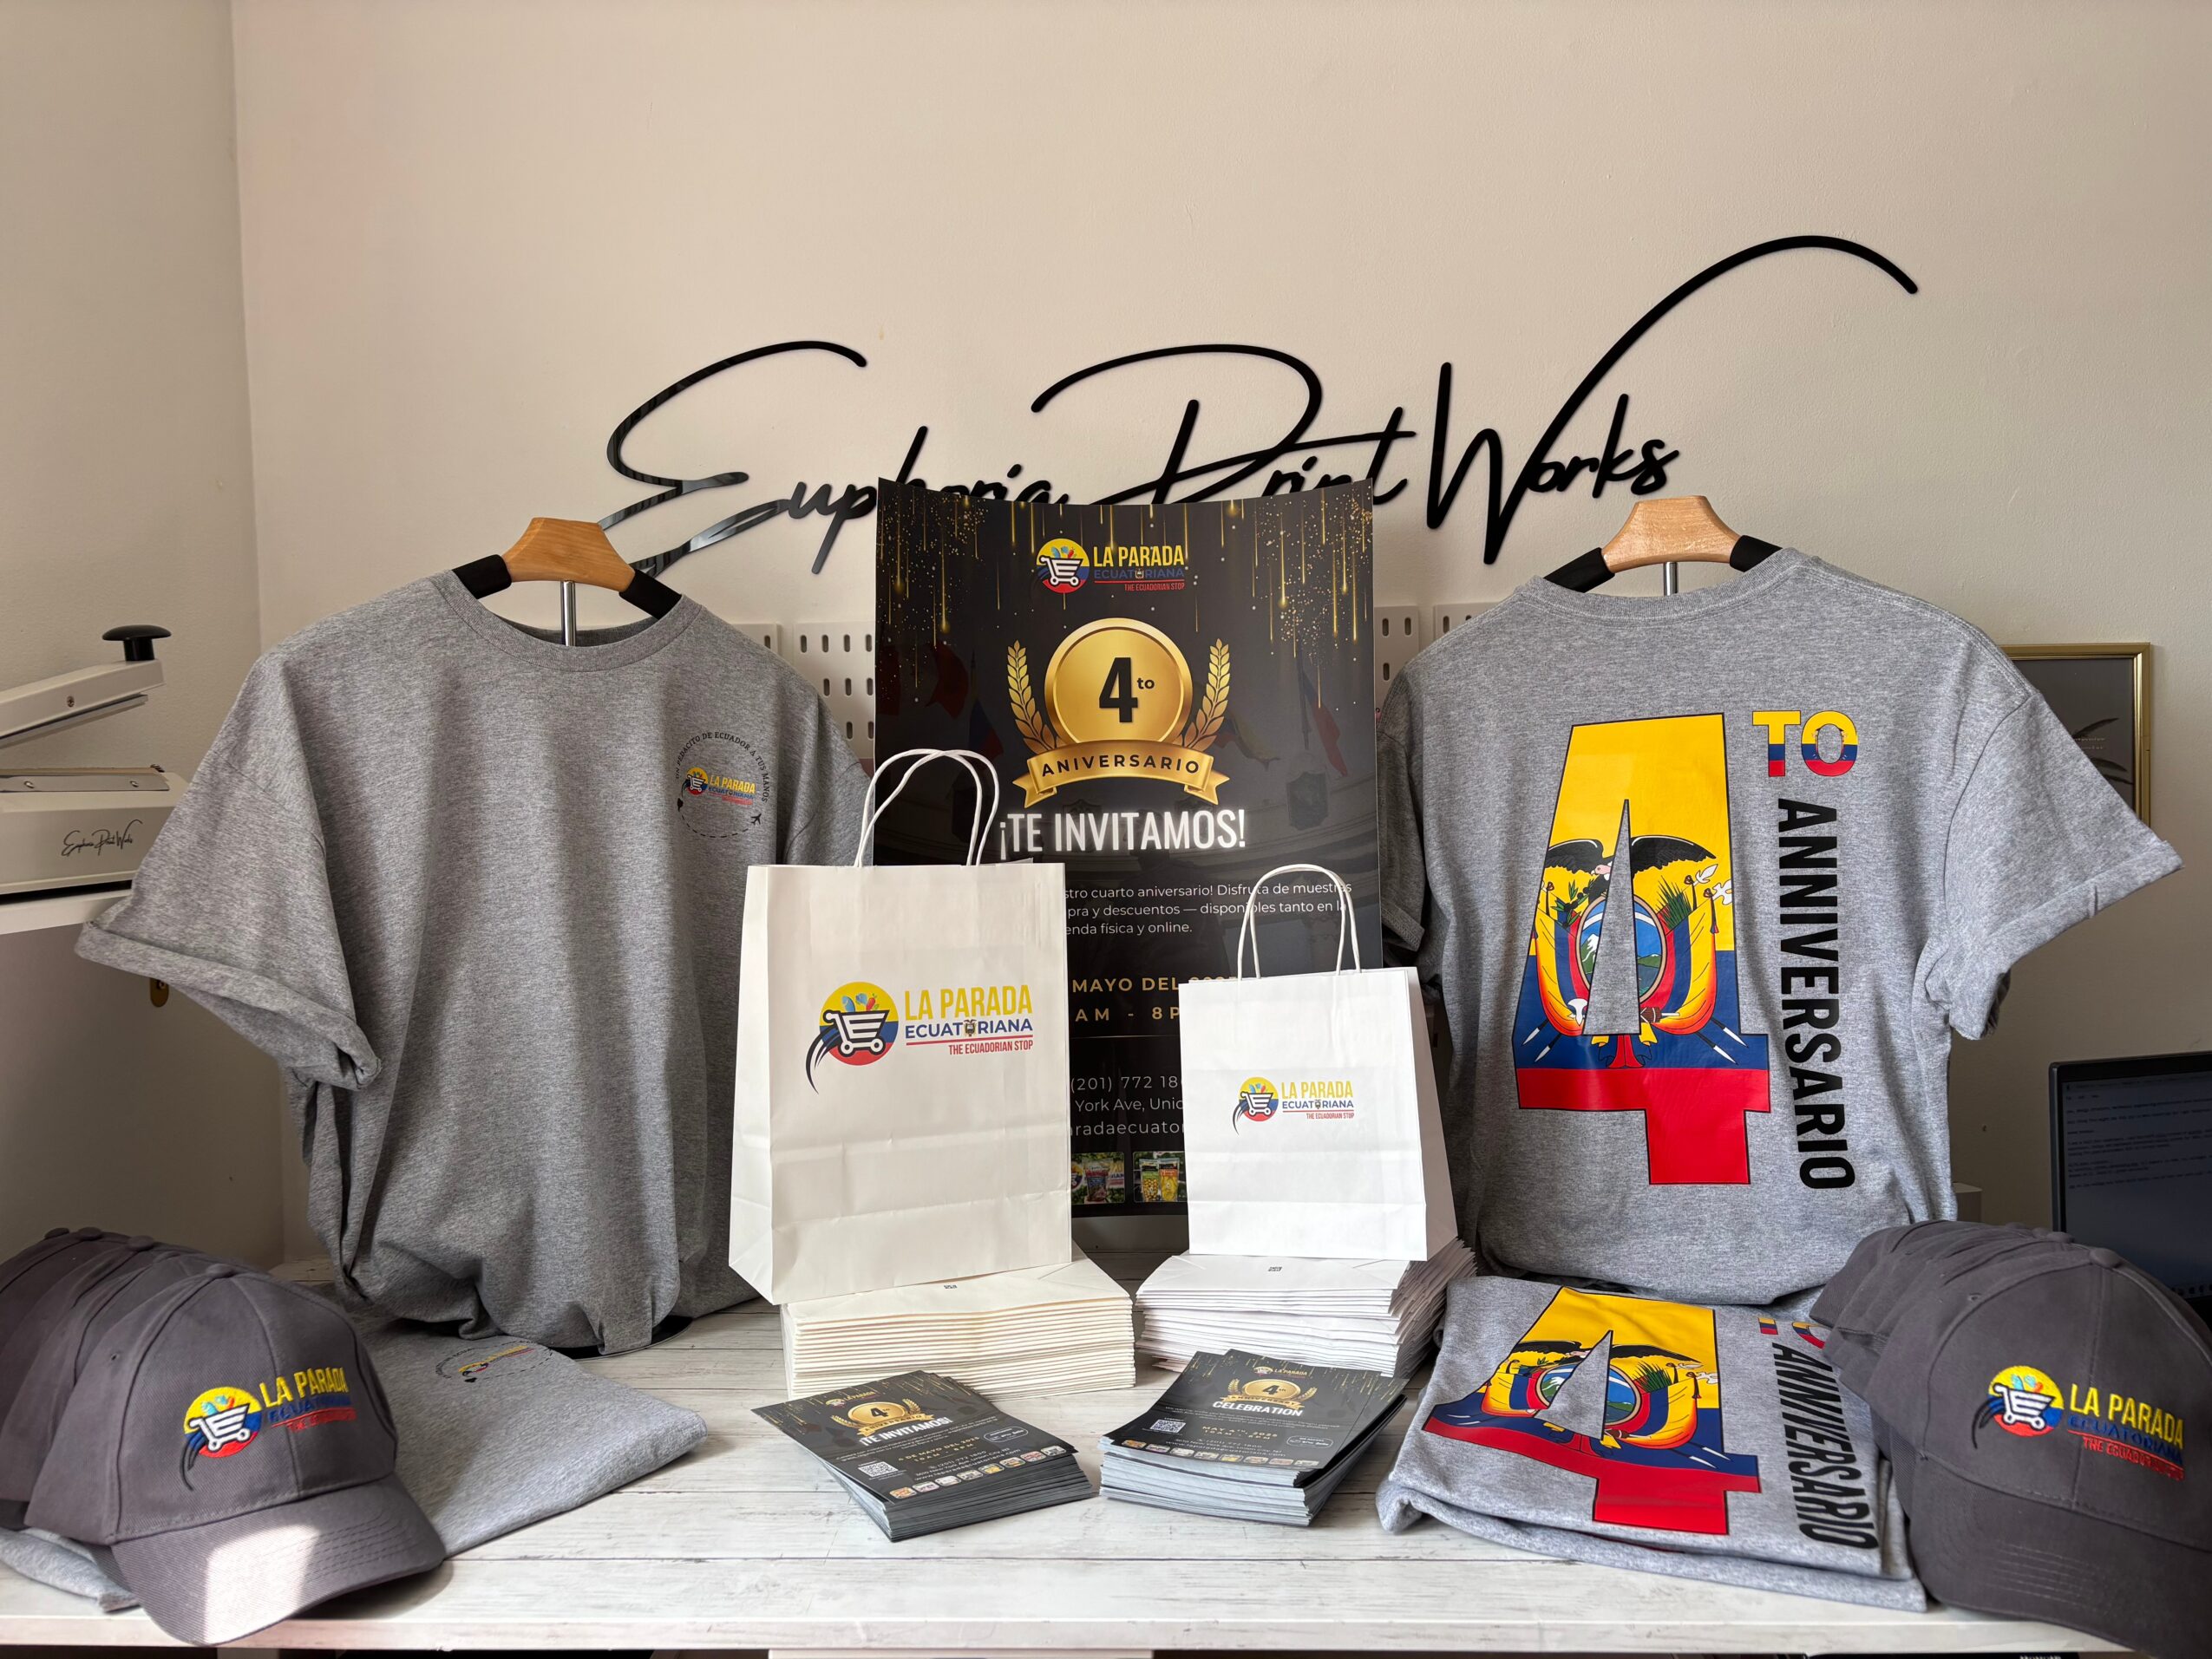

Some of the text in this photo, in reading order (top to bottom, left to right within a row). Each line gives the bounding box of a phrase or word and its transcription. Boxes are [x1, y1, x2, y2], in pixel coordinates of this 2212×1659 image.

[1427, 235, 1919, 565] Works
[1093, 545, 1185, 567] LA PARADA
[1171, 582, 1185, 591] STOP
[1751, 709, 1858, 777] TO
[677, 735, 701, 766] PEDACITO
[714, 732, 751, 751] ECUADOR
[755, 755, 767, 771] TUS
[762, 773, 771, 802] MANOS
[1042, 754, 1200, 777] ANIVERSARIO
[710, 775, 756, 794] LA PARADA
[999, 809, 1246, 860] ¡TE INVITAMOS!
[1091, 887, 1134, 898] cuarto
[1137, 885, 1214, 898] aniversario!
[1273, 883, 1289, 894] de
[1068, 907, 1089, 918] pra
[1092, 908, 1100, 919] y
[1103, 905, 1180, 916] descuentos
[1200, 902, 1276, 916] disponbles
[1279, 902, 1314, 912] tanto
[1318, 903, 1333, 911] en
[1101, 922, 1134, 934] física
[1136, 924, 1145, 936] y
[1148, 921, 1193, 933] online.
[1511, 712, 1771, 1185] 4
[1072, 976, 1179, 993] MAYO DEL
[1777, 798, 1855, 1191] ANNIVERSARIO
[904, 984, 1033, 1021] LA PARADA
[949, 1040, 1033, 1055] THE ECUADORIAN STOP
[1070, 1076, 1112, 1094] (201)
[1121, 1075, 1152, 1089] 772
[1281, 1081, 1353, 1099] LA PARADA
[1075, 1097, 1109, 1112] York
[1113, 1098, 1145, 1112] Ave,
[259, 1367, 349, 1408] LA PARADA
[1213, 1401, 1303, 1416] CELEBRATION
[1423, 1286, 1762, 1535] 4
[2070, 1383, 2184, 1449] LA PARADA
[880, 1416, 954, 1440] INVITAMOS!
[1772, 1342, 1879, 1550] ANNIVERSARIO
[2083, 1435, 2104, 1453] THE
